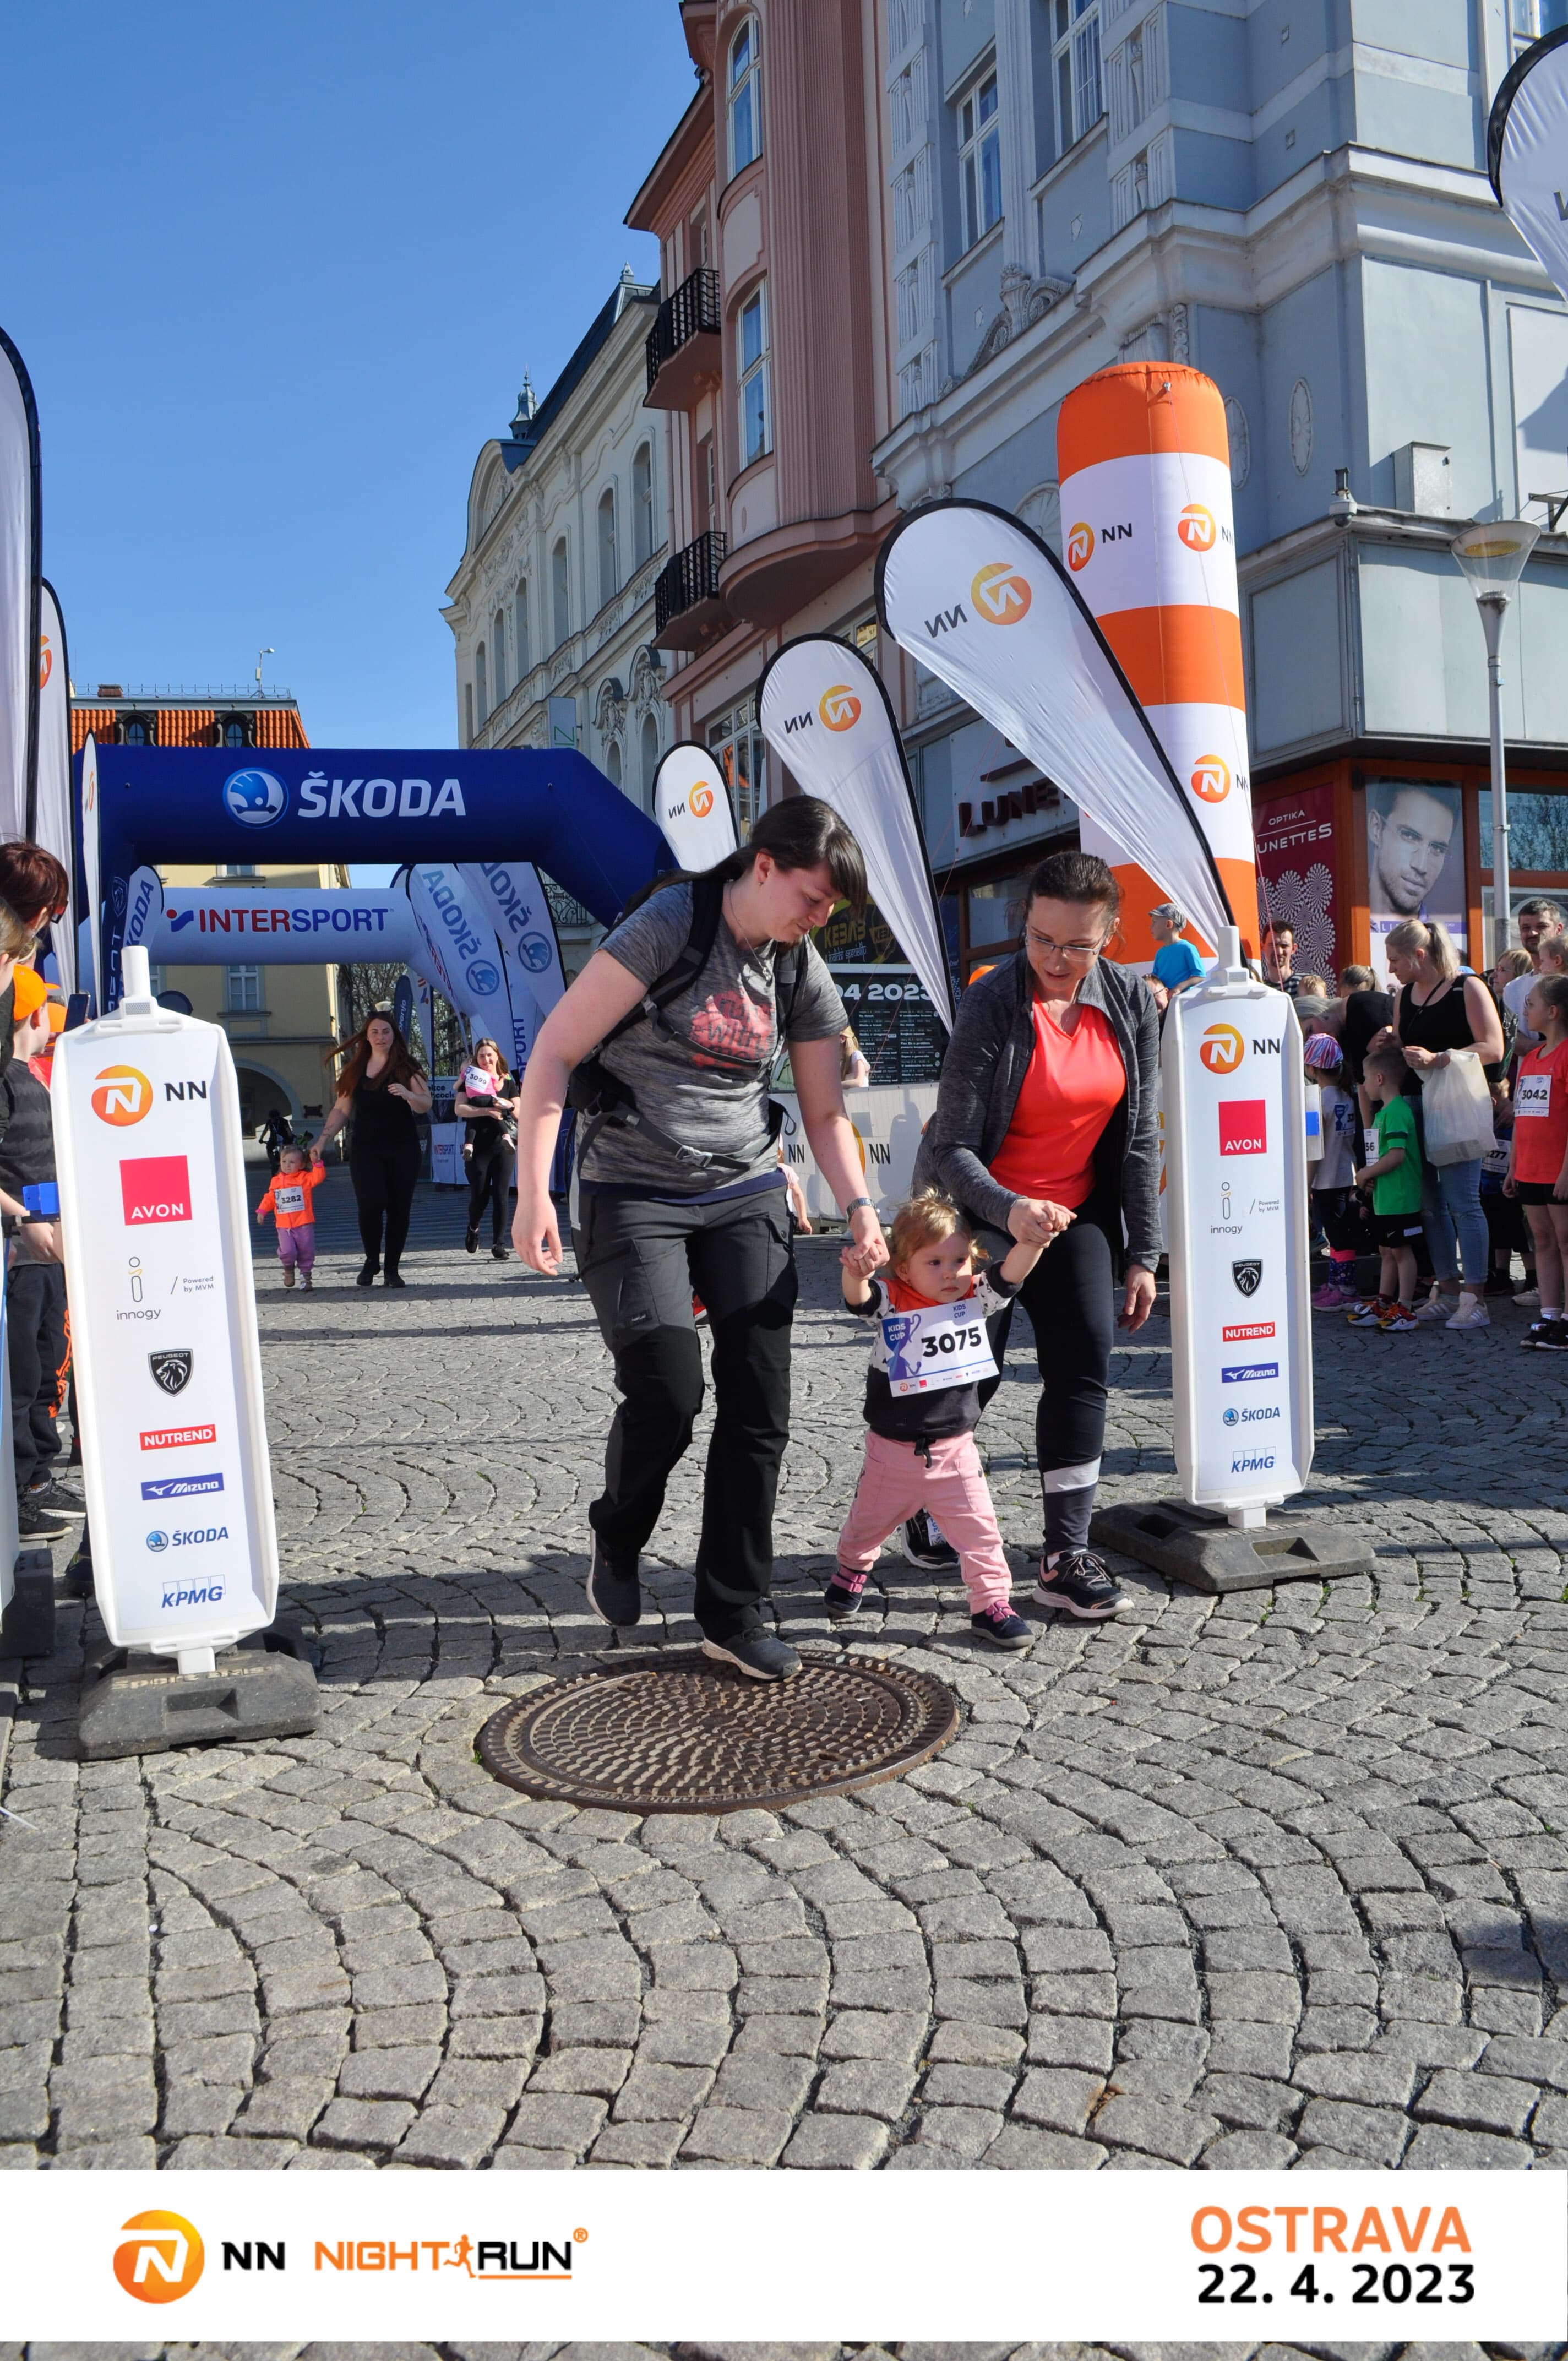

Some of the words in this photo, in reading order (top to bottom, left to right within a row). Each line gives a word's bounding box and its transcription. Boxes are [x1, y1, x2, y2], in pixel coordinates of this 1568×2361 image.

[1102, 523, 1133, 543] NN
[1221, 526, 1233, 543] NN
[297, 771, 466, 818] ŠKODA
[959, 776, 1070, 837] LUNE
[1268, 810, 1305, 825] OPTIKA
[1257, 823, 1332, 854] UNETTES
[126, 880, 154, 946] KODA
[199, 908, 388, 932] INTERSPORT
[1253, 1038, 1280, 1054] NN
[470, 1074, 487, 1084] 3099
[164, 1081, 208, 1101] NN
[1521, 1089, 1548, 1100] 3042
[1224, 1139, 1261, 1151] AVON
[1365, 1142, 1375, 1151] 56
[788, 1144, 804, 1163] NN
[869, 1144, 891, 1164] NN
[1488, 1150, 1507, 1160] 277
[281, 1195, 301, 1204] 3282
[131, 1203, 184, 1220] AVON
[1211, 1225, 1243, 1234] innogy
[183, 1275, 214, 1285] Powered
[195, 1283, 214, 1292] MVM
[117, 1308, 162, 1321] innogy
[888, 1323, 906, 1332] KIDS
[1226, 1325, 1273, 1339] NUTREND
[890, 1332, 906, 1341] CUP
[921, 1326, 981, 1357] 3075
[153, 1352, 189, 1361] PEUGEOT
[1241, 1407, 1280, 1422] ŠKODA
[144, 1428, 213, 1446] NUTREND
[1231, 1456, 1275, 1473] KPMG
[172, 1526, 229, 1546] ŠKODA
[161, 1586, 223, 1608] KPMG
